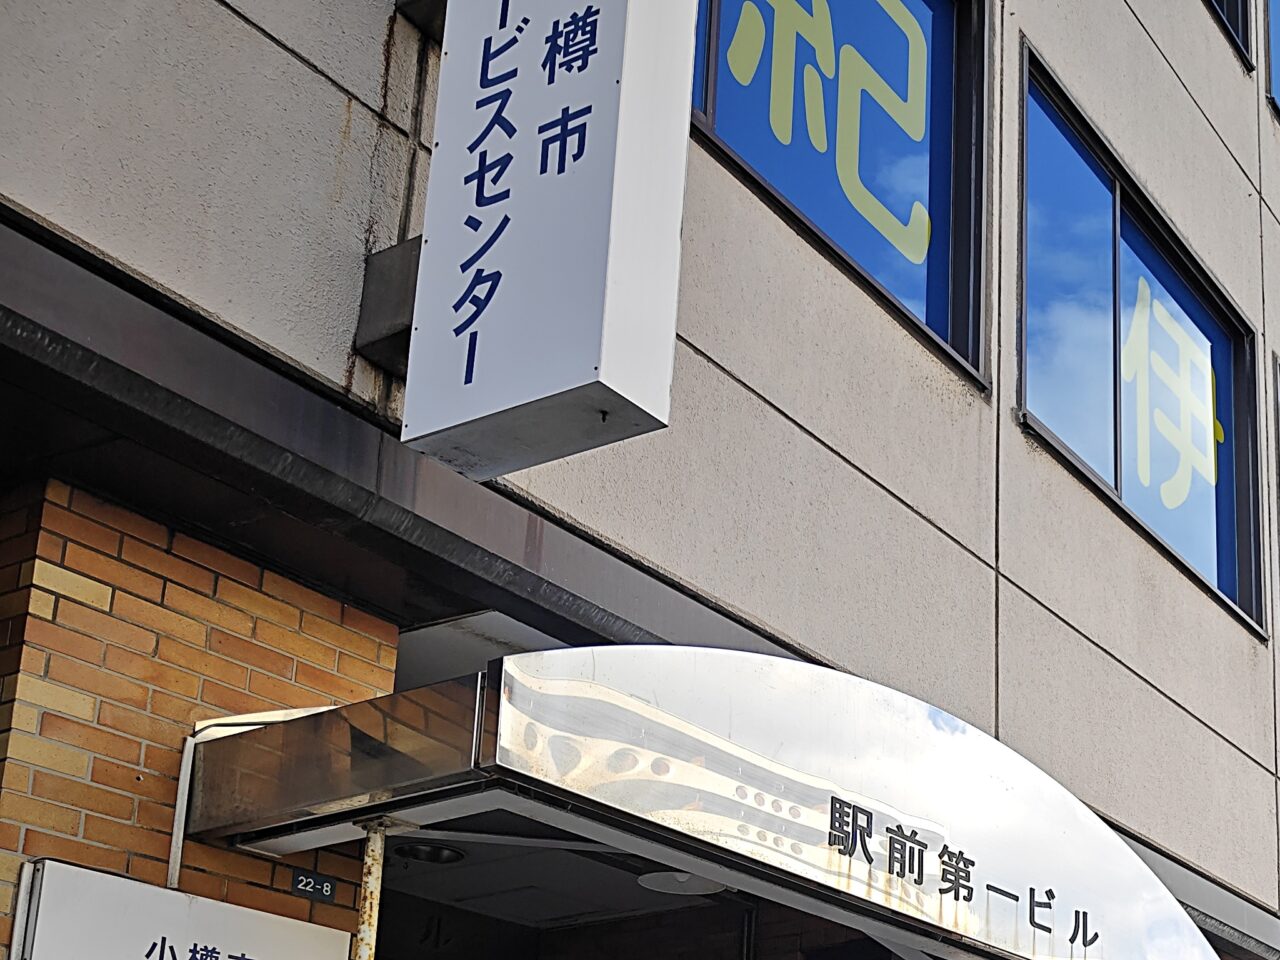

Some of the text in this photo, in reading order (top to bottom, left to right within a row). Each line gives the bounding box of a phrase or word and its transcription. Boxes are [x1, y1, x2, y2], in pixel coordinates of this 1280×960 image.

[538, 5, 600, 175] 樽市
[1122, 275, 1223, 510] 伊
[297, 875, 332, 896] 22-8
[828, 795, 1099, 948] 駅前第一ビル
